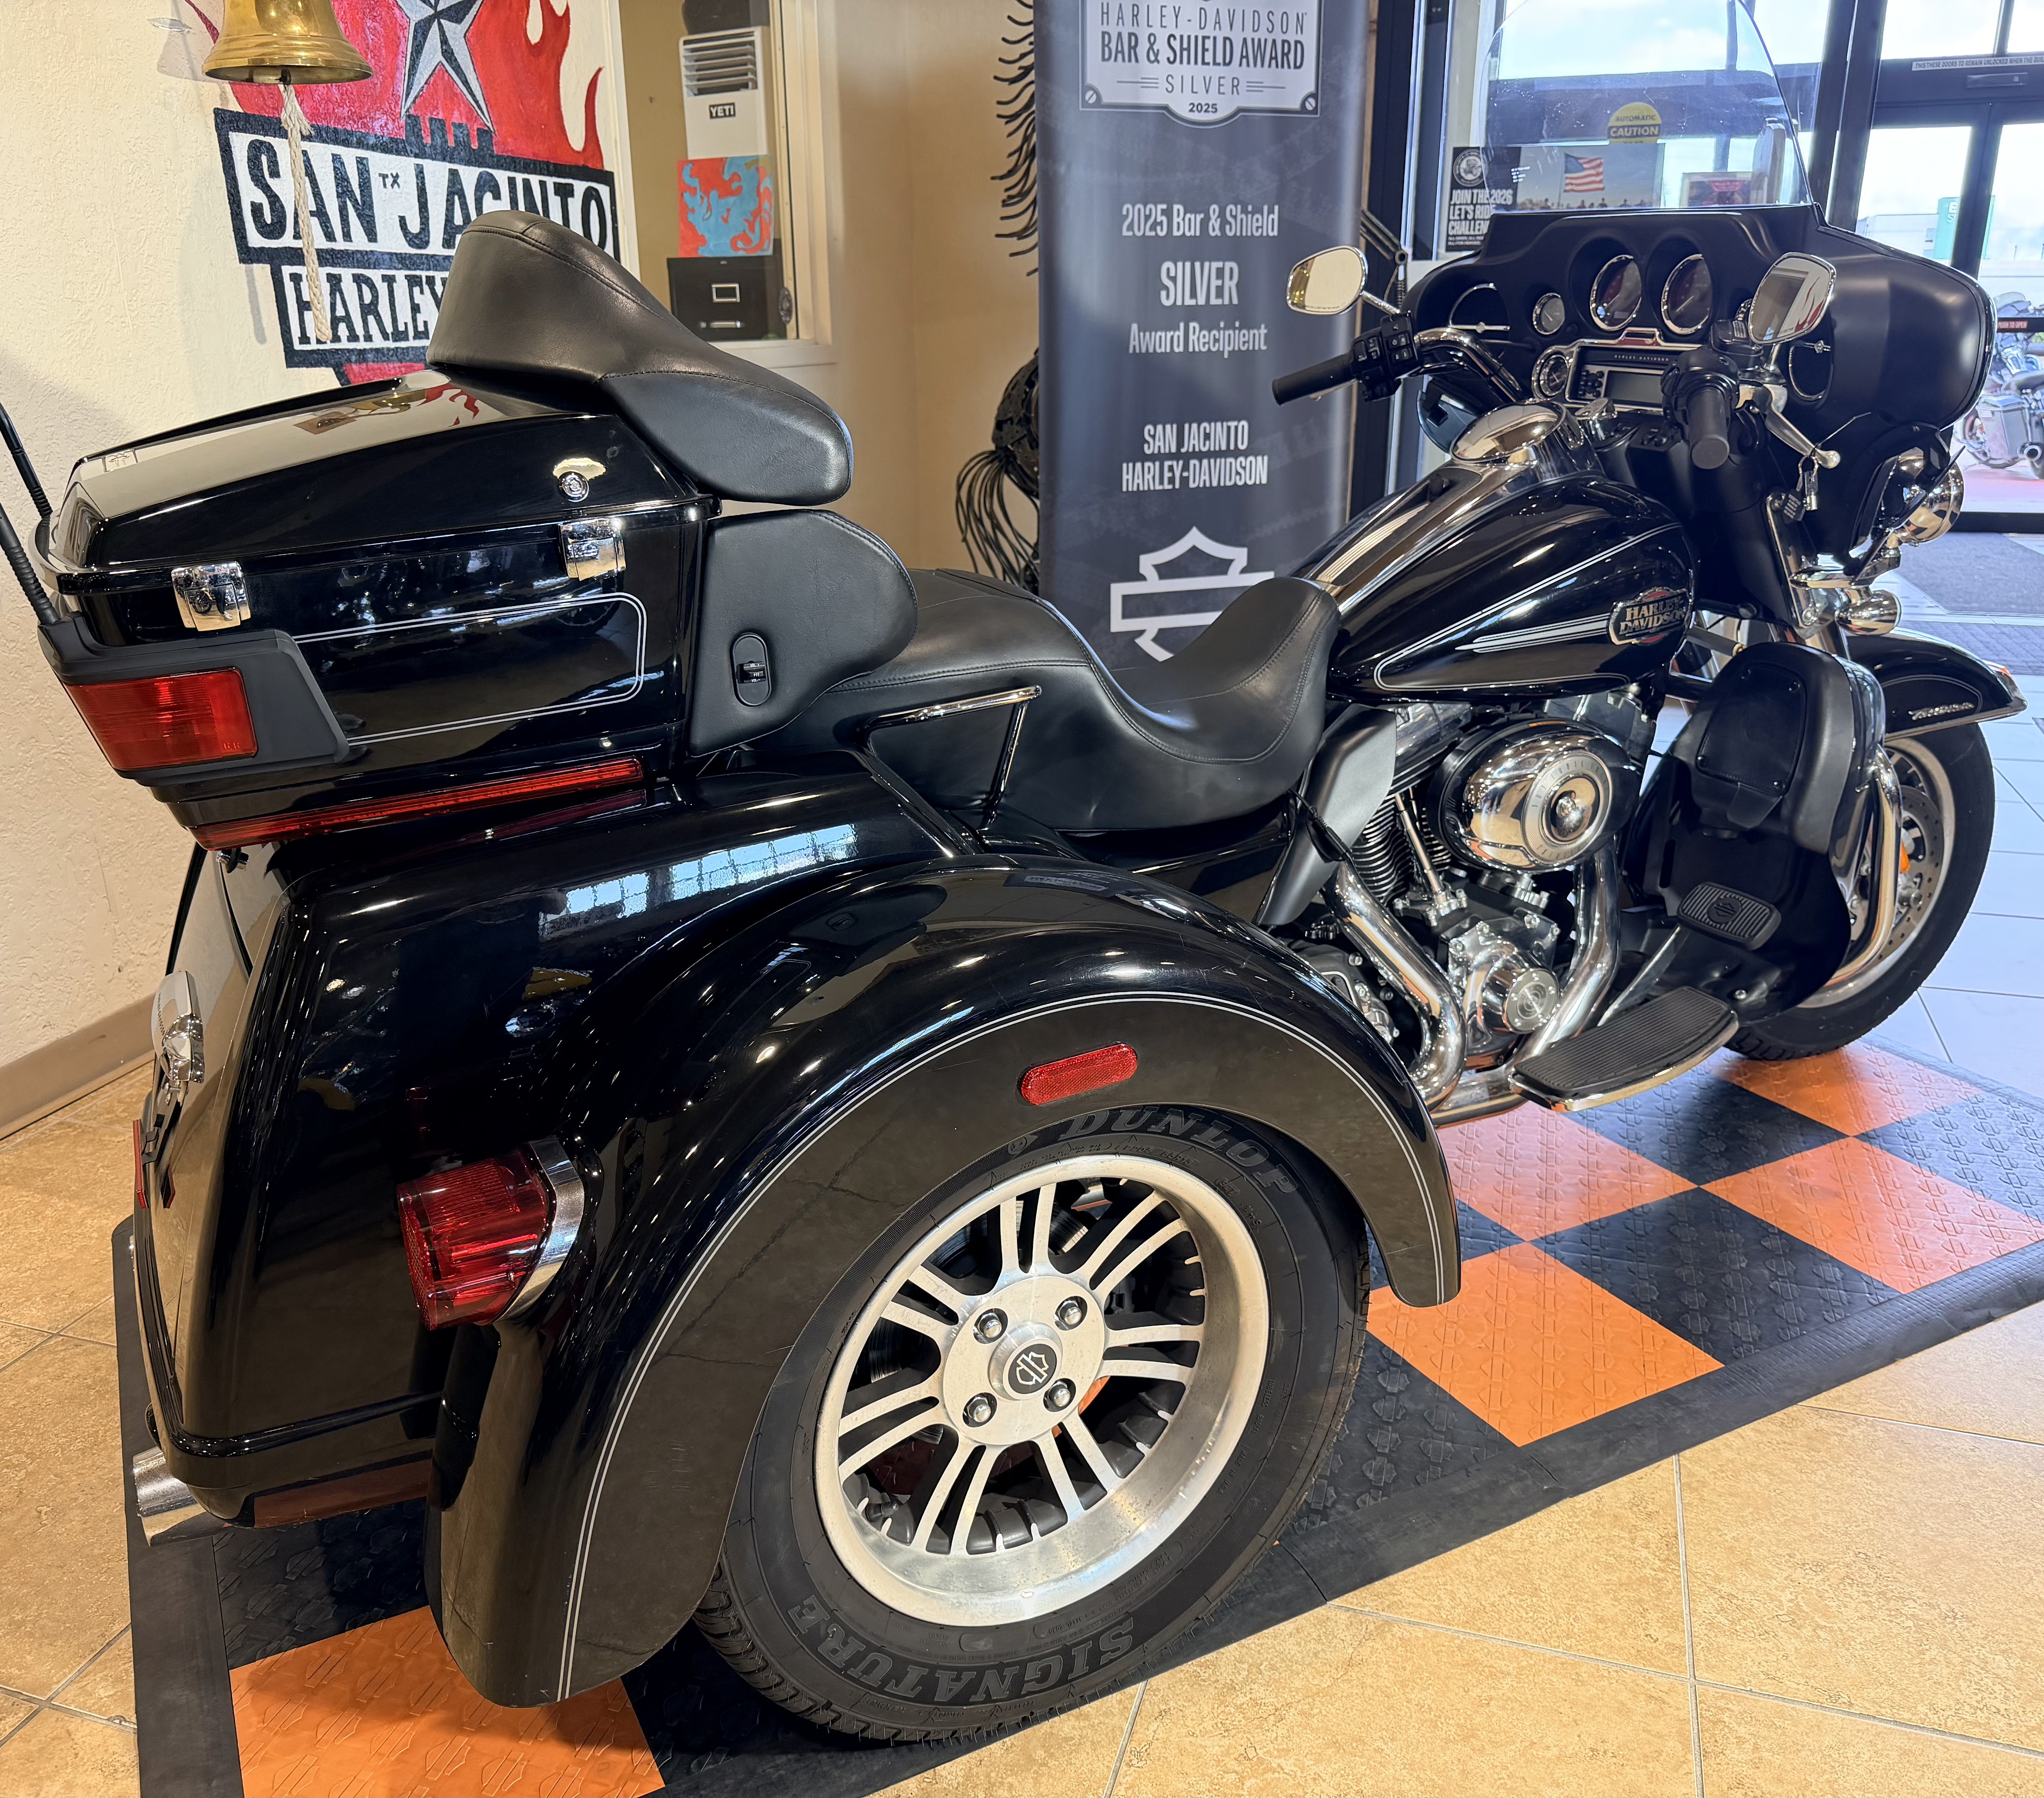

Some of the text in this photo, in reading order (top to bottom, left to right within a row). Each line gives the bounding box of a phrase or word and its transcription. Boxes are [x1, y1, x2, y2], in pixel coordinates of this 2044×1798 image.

[1101, 31, 1304, 70] BAR & SHIELD AWARD
[1165, 74, 1240, 95] SILVER
[710, 105, 734, 117] YETI
[1188, 102, 1218, 114] 2025
[1615, 114, 1656, 122] AUTOMATIC
[1610, 126, 1659, 137] CAUTION
[246, 139, 378, 243] SAN
[378, 172, 401, 190] TX
[1451, 189, 1513, 205] JOIN THE 2026
[1122, 203, 1279, 237] 2025 Bar & Shield
[1449, 204, 1475, 220] LET'S
[1449, 220, 1490, 235] CHALLEN
[1160, 261, 1239, 306] SILVER
[1129, 321, 1268, 358] Award Recipient
[1143, 420, 1249, 455] SAN JACINTO
[1122, 455, 1268, 492] HARLEY-DAVIDSON
[1057, 1105, 1300, 1194] DUNLOP
[787, 1595, 1135, 1702] SIGNATURE
